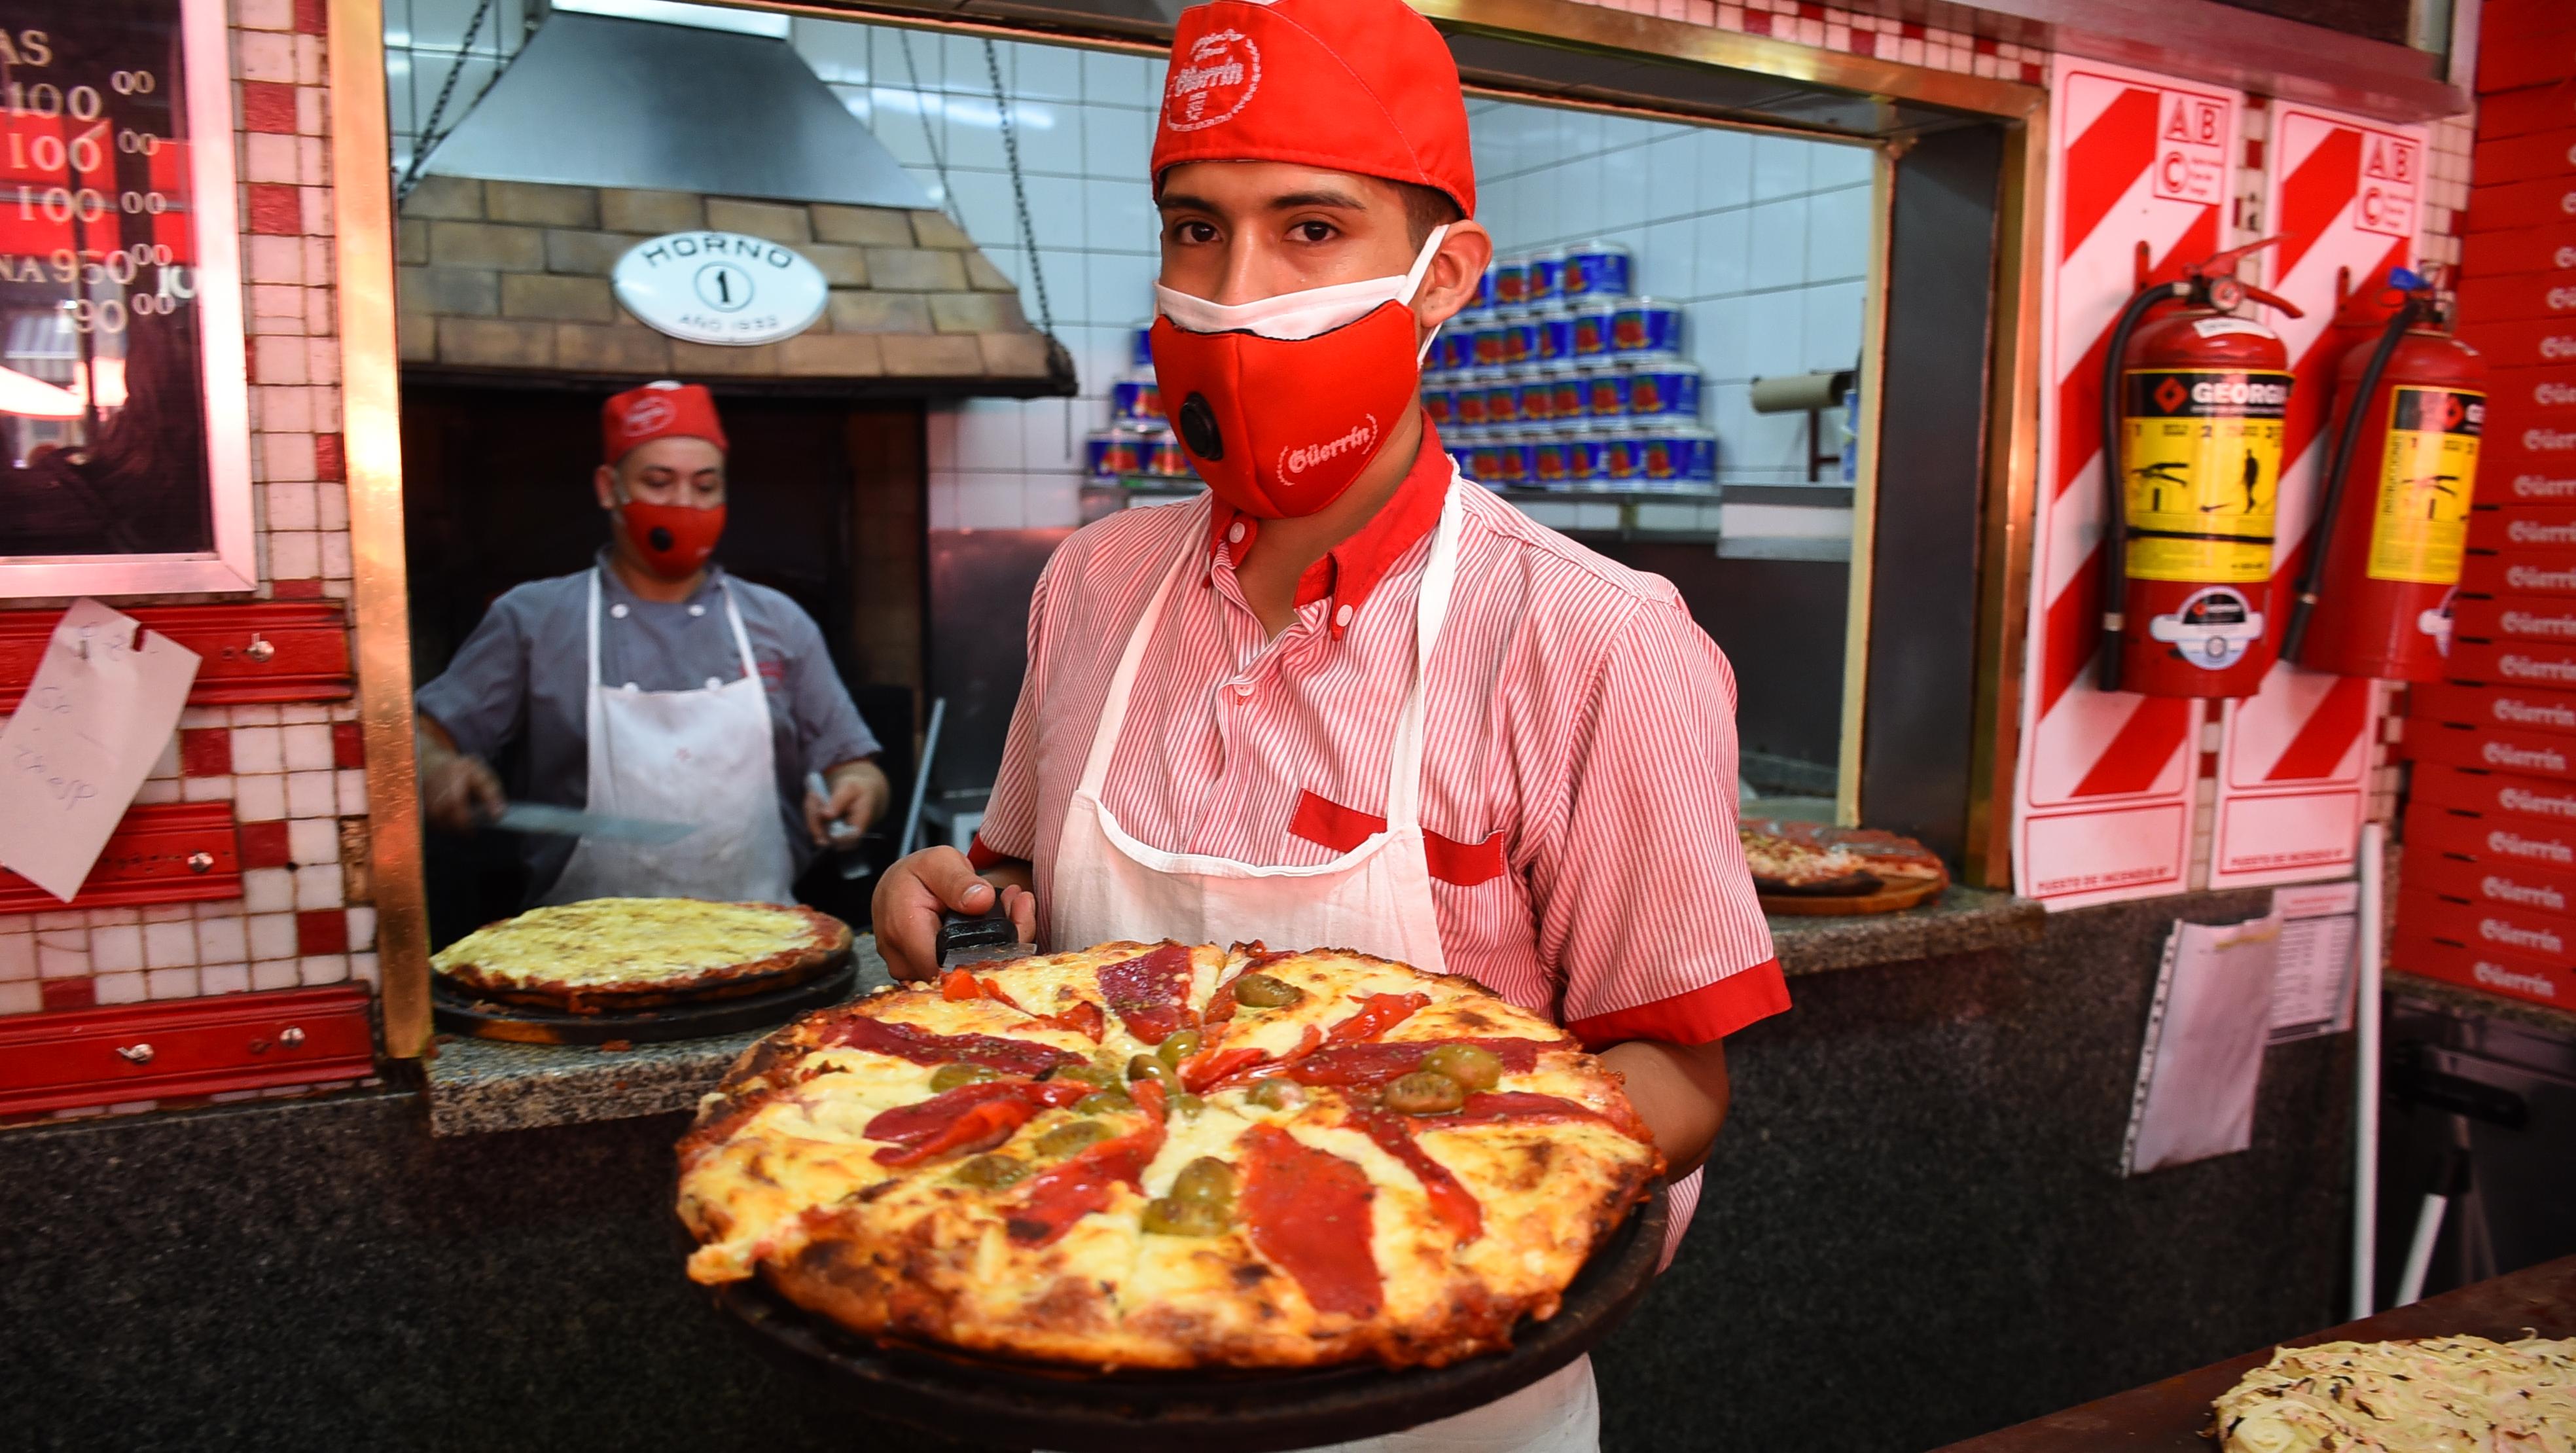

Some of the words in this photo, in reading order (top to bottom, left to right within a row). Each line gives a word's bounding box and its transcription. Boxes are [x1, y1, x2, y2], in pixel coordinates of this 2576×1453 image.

[9, 82, 102, 122] 100
[111, 70, 155, 95] 00
[2168, 101, 2189, 136] A
[2202, 108, 2216, 139] B
[9, 133, 101, 172] 100
[118, 130, 160, 156] 00
[2368, 139, 2386, 174] A
[2163, 152, 2185, 192] C
[18, 185, 105, 223] 100
[121, 191, 167, 215] 00
[642, 236, 793, 268] HORNO
[716, 270, 730, 304] 1
